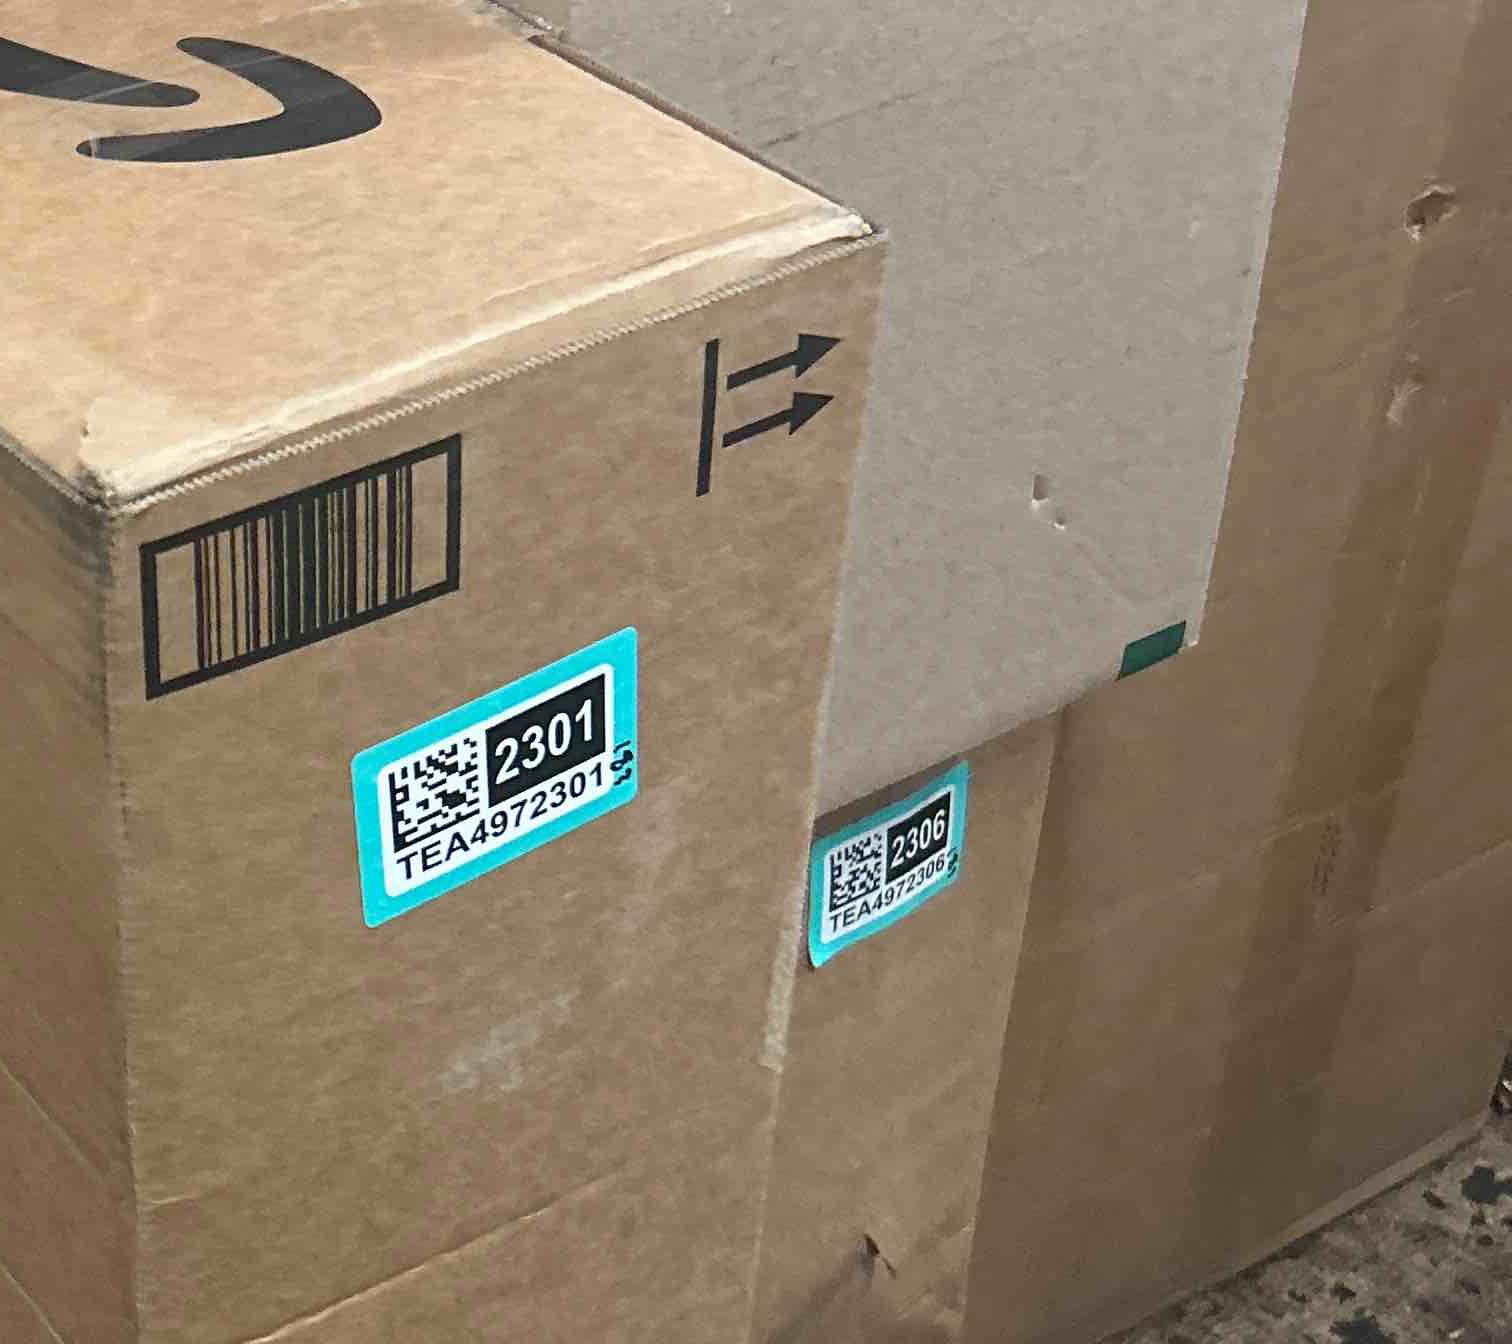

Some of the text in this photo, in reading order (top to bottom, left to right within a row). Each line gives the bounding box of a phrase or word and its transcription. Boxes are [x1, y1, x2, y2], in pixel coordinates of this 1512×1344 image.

[493, 698, 594, 786] 2301
[395, 761, 605, 881] TEA4972301
[890, 808, 945, 868] 2306
[829, 854, 945, 933] TEA4972306
